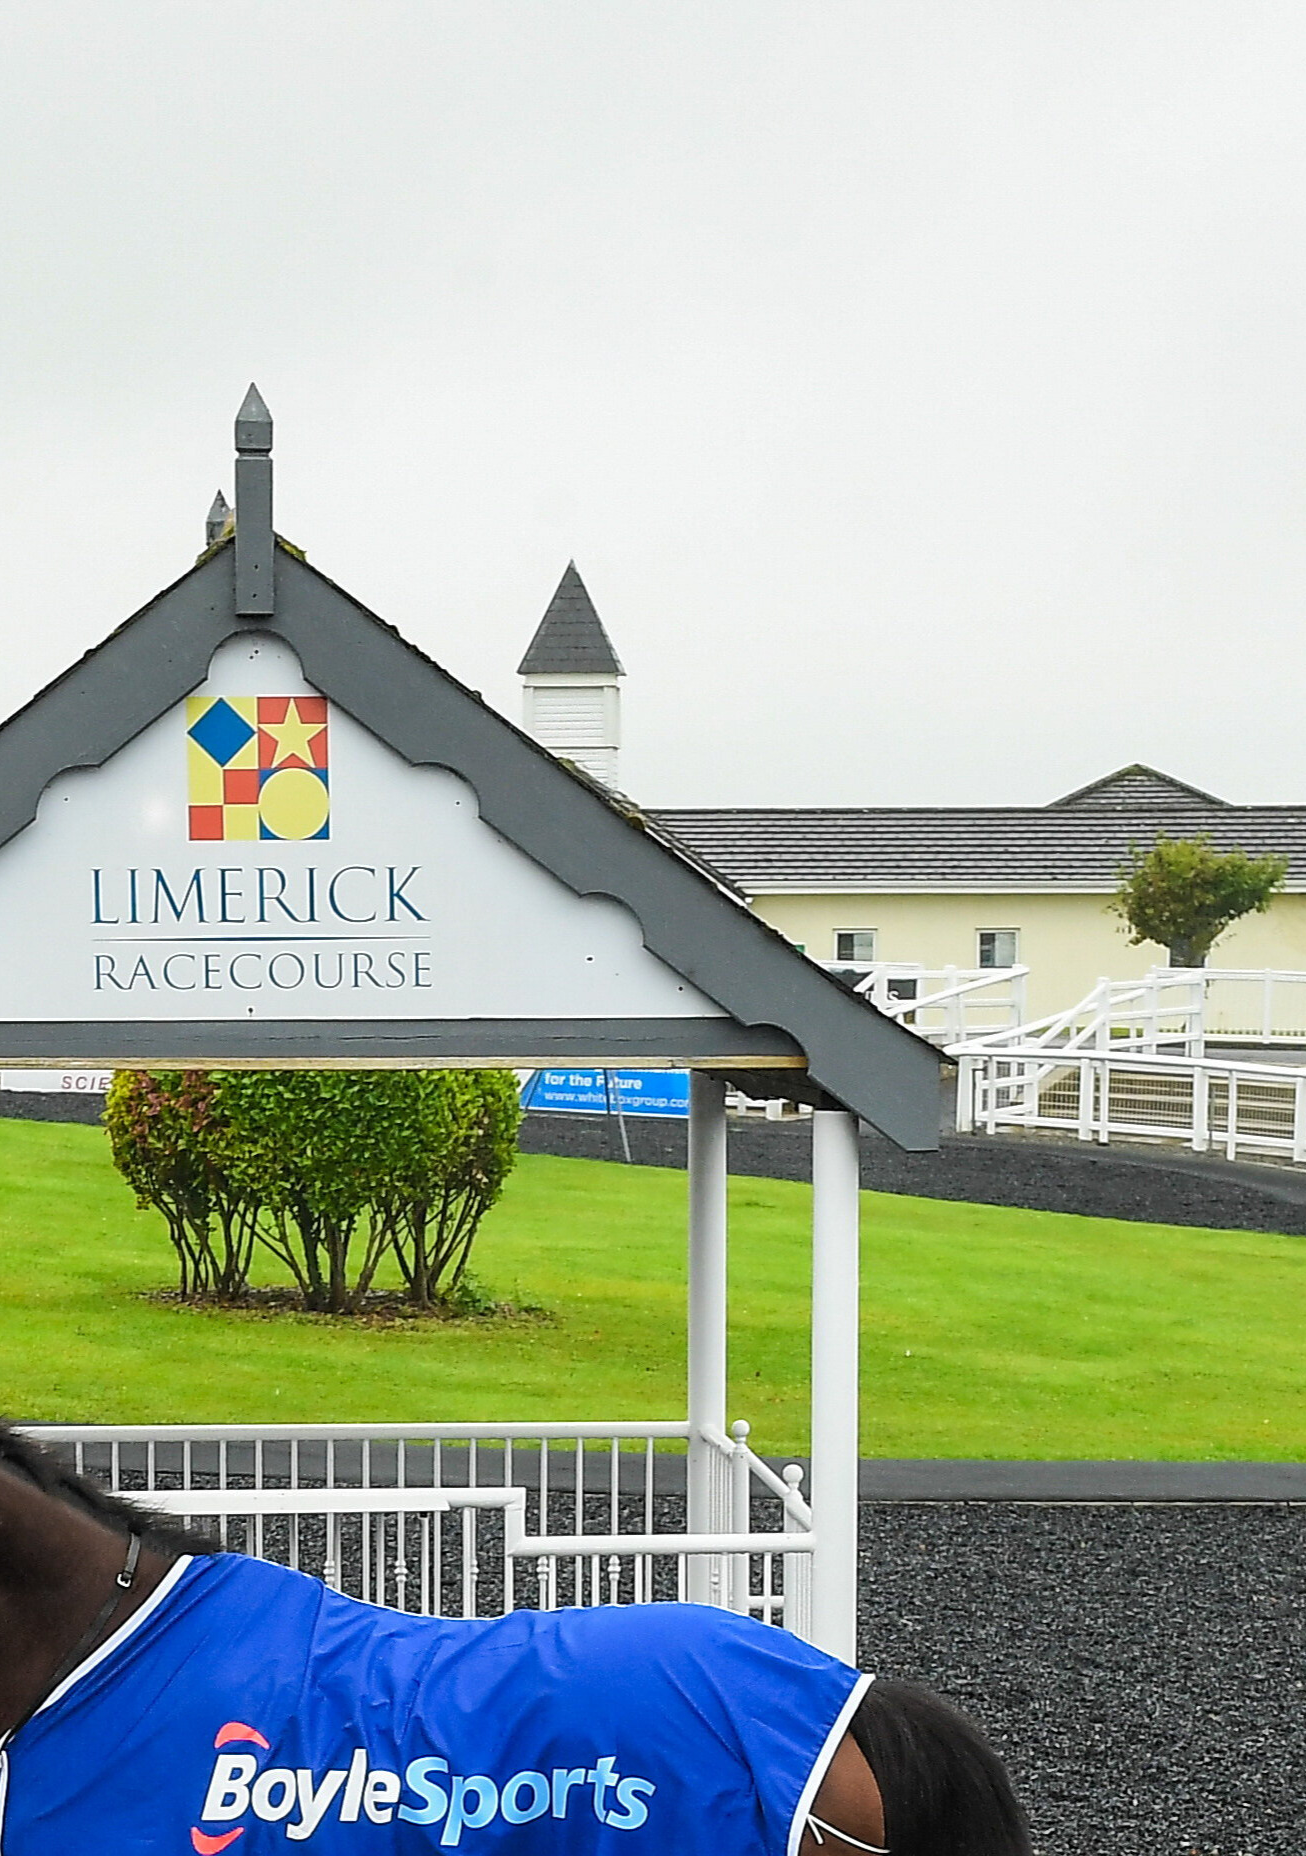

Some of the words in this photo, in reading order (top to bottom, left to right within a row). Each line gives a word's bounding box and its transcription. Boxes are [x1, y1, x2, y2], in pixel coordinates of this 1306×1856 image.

[90, 865, 432, 924] LIMERICK
[93, 951, 433, 990] RACECOURSE
[545, 1072, 565, 1085] for
[569, 1073, 592, 1087] the
[200, 1747, 657, 1847] BoyleSports
